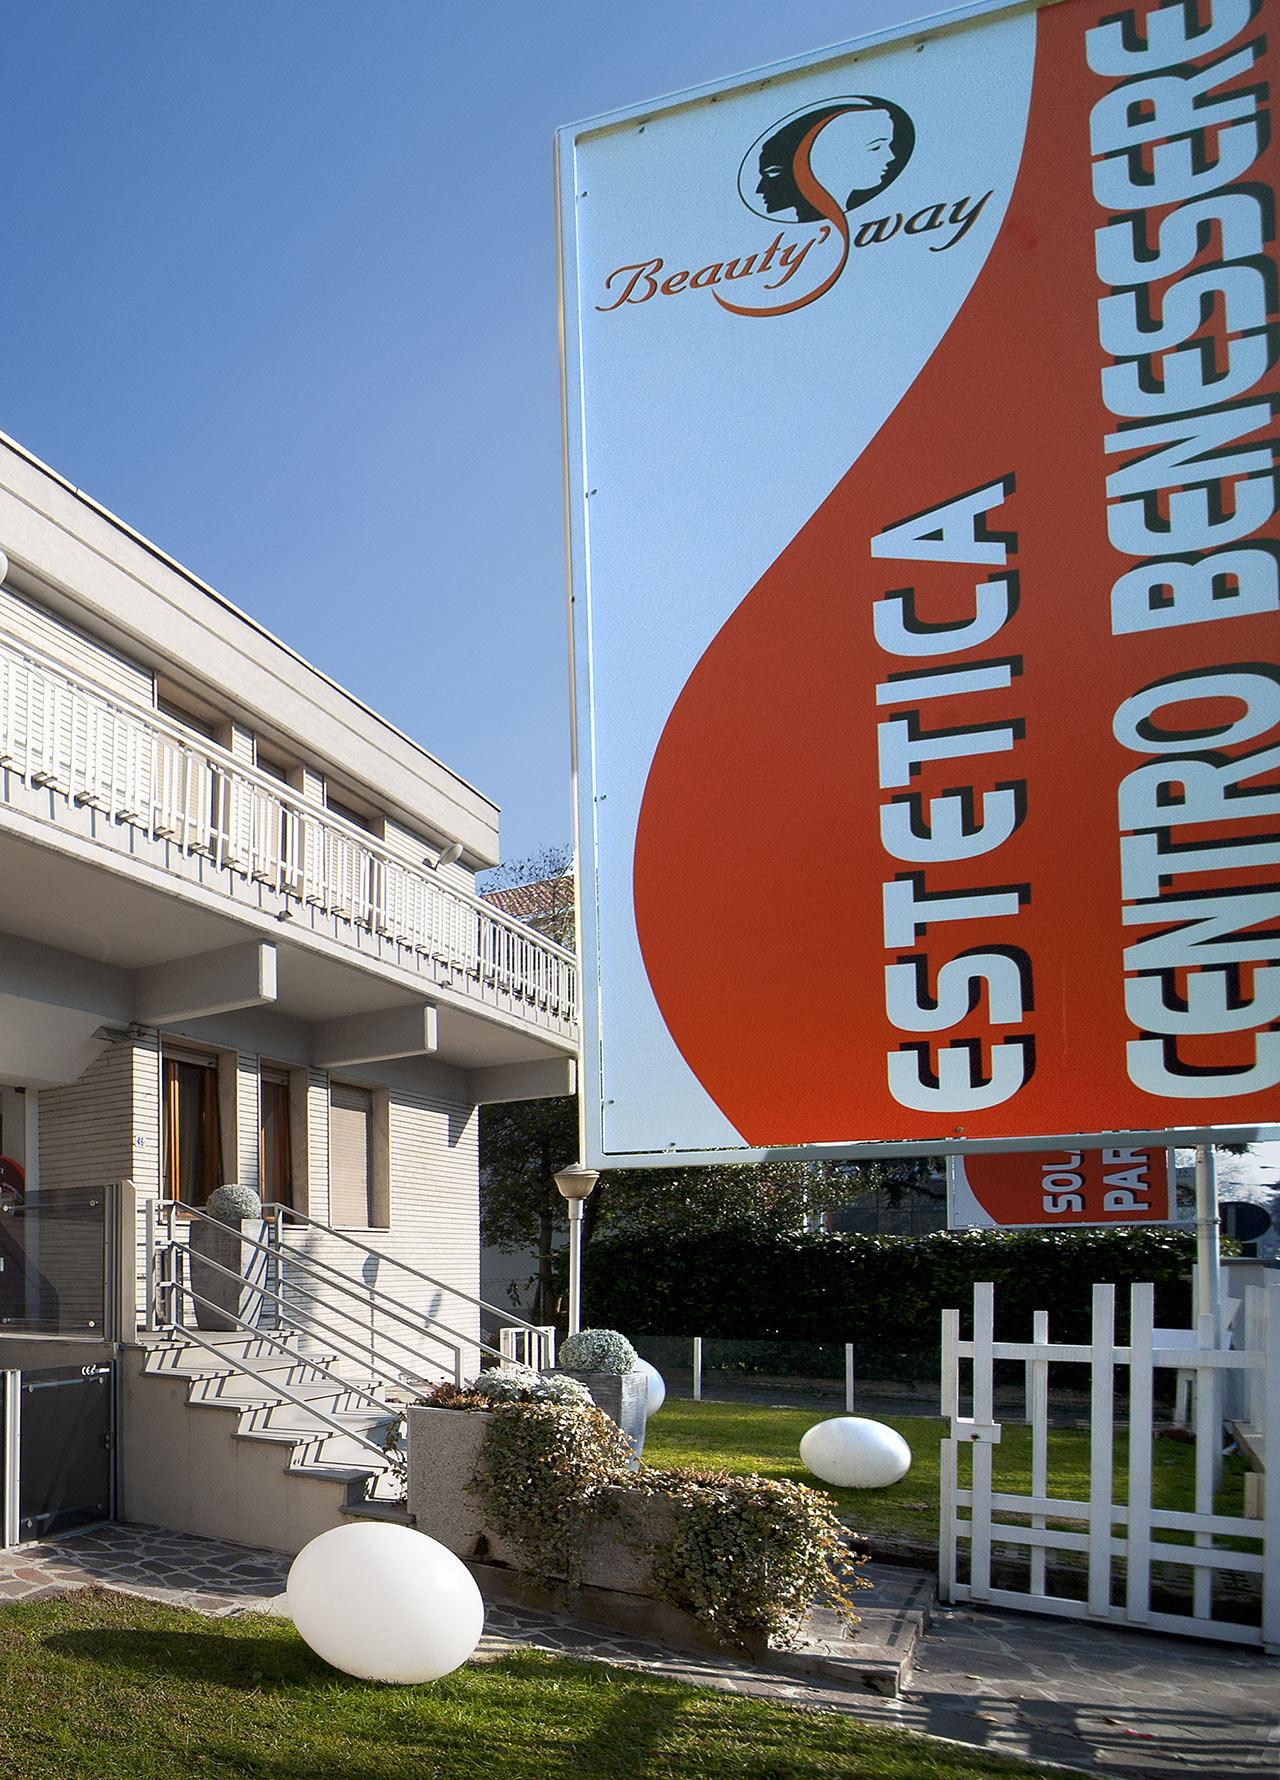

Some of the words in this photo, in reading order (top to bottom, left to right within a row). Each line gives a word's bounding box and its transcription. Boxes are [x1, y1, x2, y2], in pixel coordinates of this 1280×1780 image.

[1084, 0, 1280, 637] BENESSERE
[870, 473, 1036, 1113] ESTETICA
[1111, 664, 1280, 1099] CENTRO
[1042, 1149, 1085, 1214] SOL
[1102, 1148, 1152, 1212] PAR
